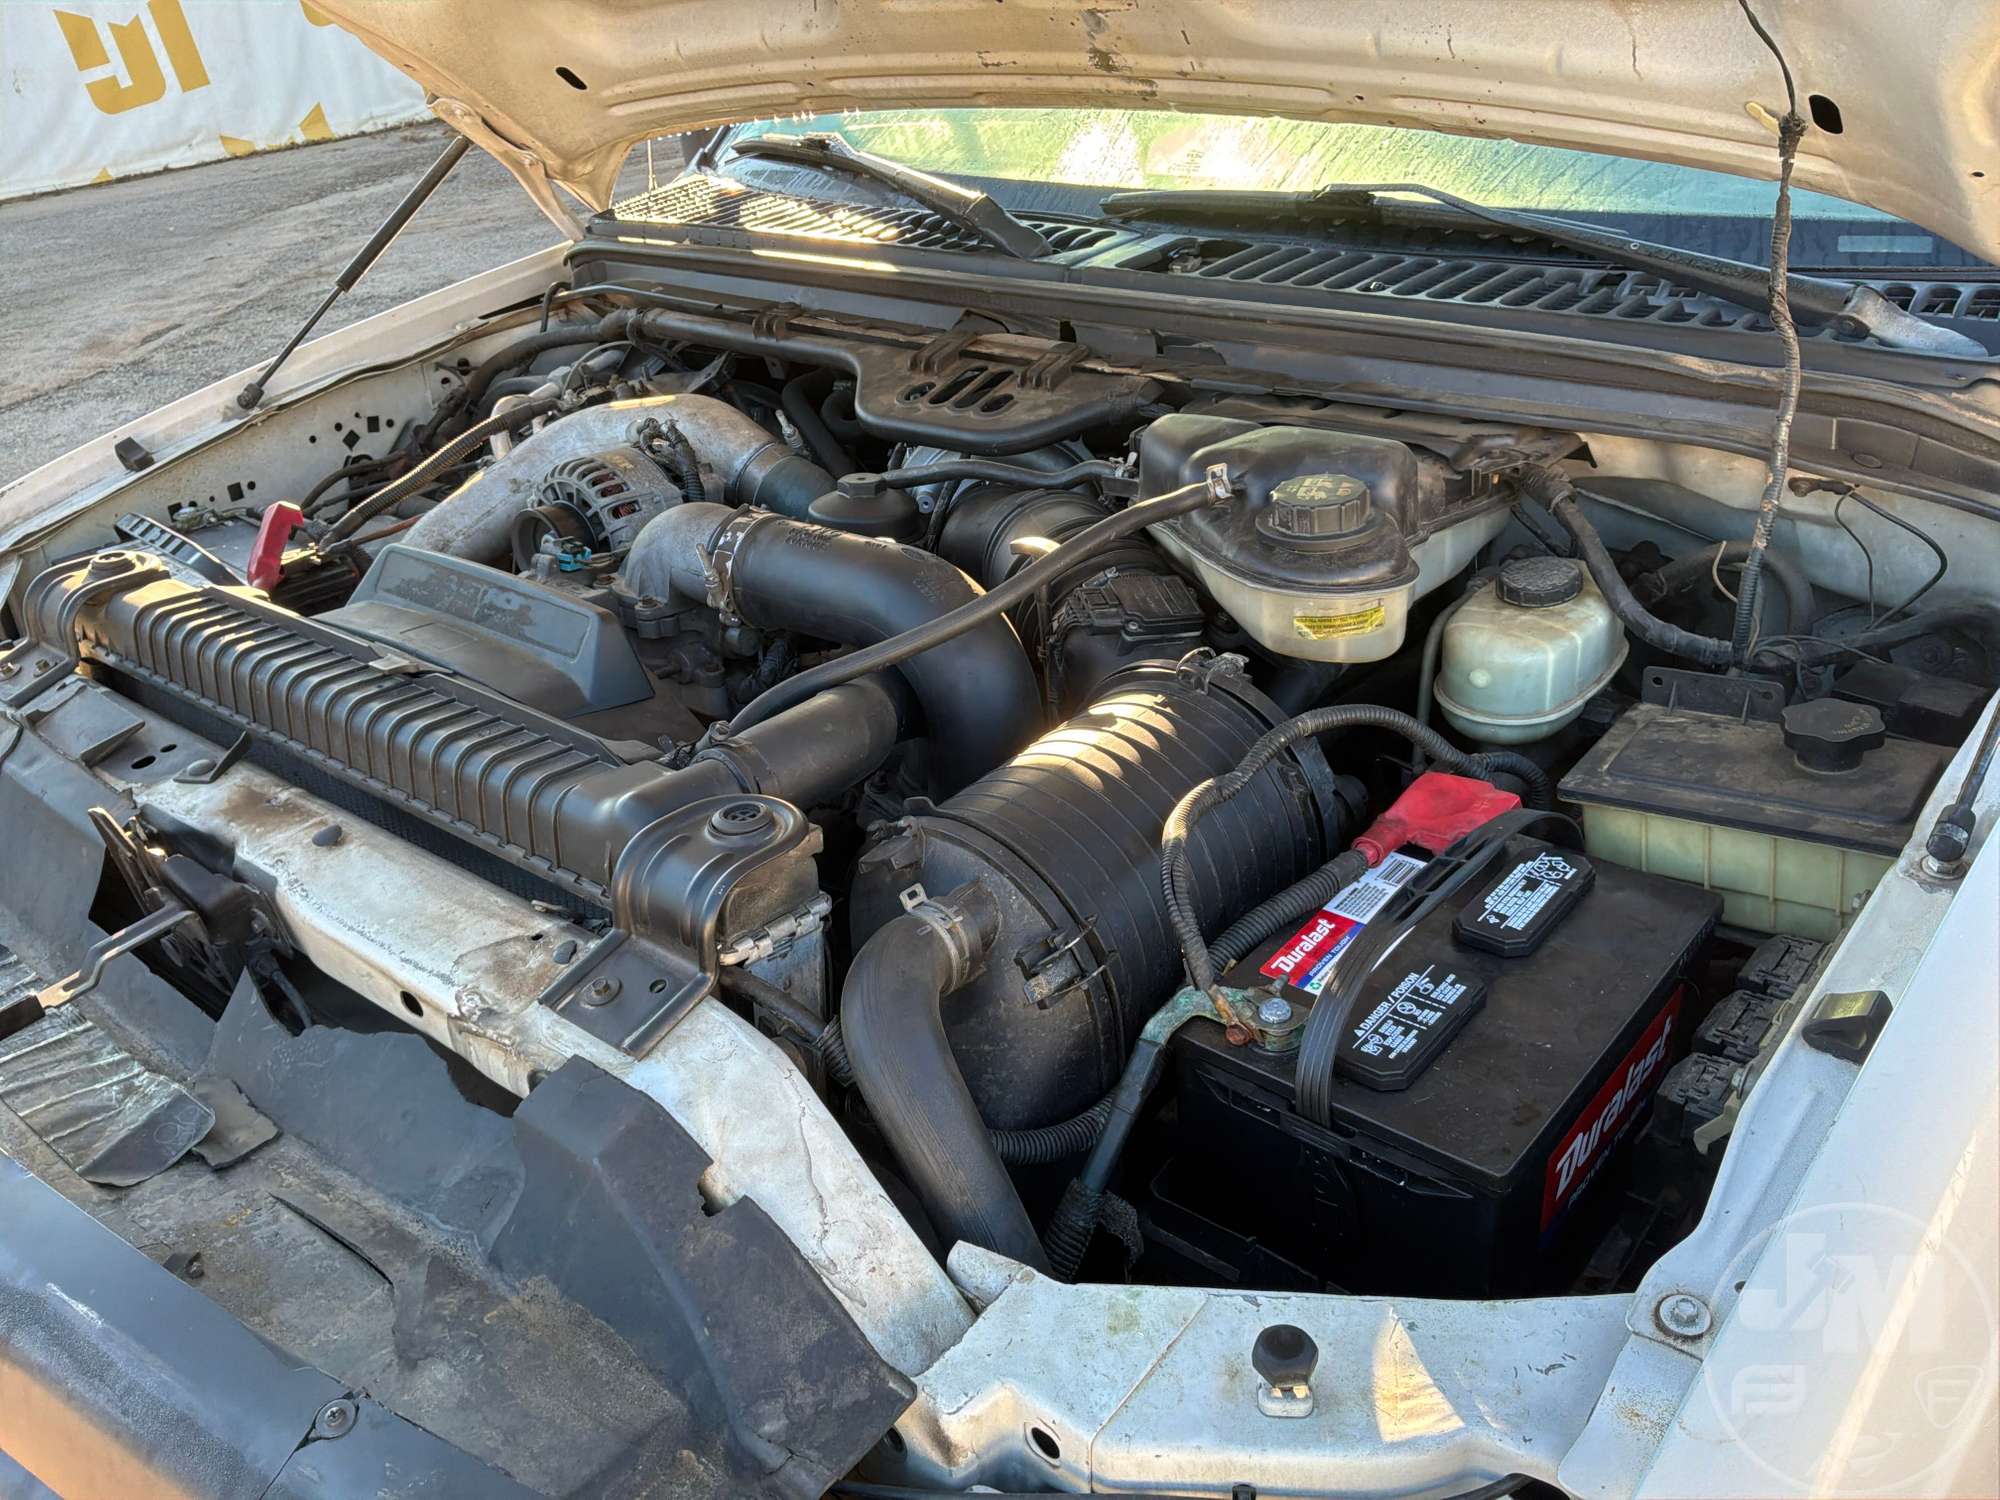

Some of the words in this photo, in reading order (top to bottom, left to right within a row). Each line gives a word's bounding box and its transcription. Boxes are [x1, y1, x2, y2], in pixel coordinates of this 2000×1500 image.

[1271, 918, 1335, 973] Duralast
[1308, 953, 1333, 976] PROVEN
[1330, 935, 1351, 954] TOUGH
[1360, 1001, 1392, 1030] DANGER
[1391, 972, 1420, 997] POISON
[1556, 1016, 1672, 1200] Duralast
